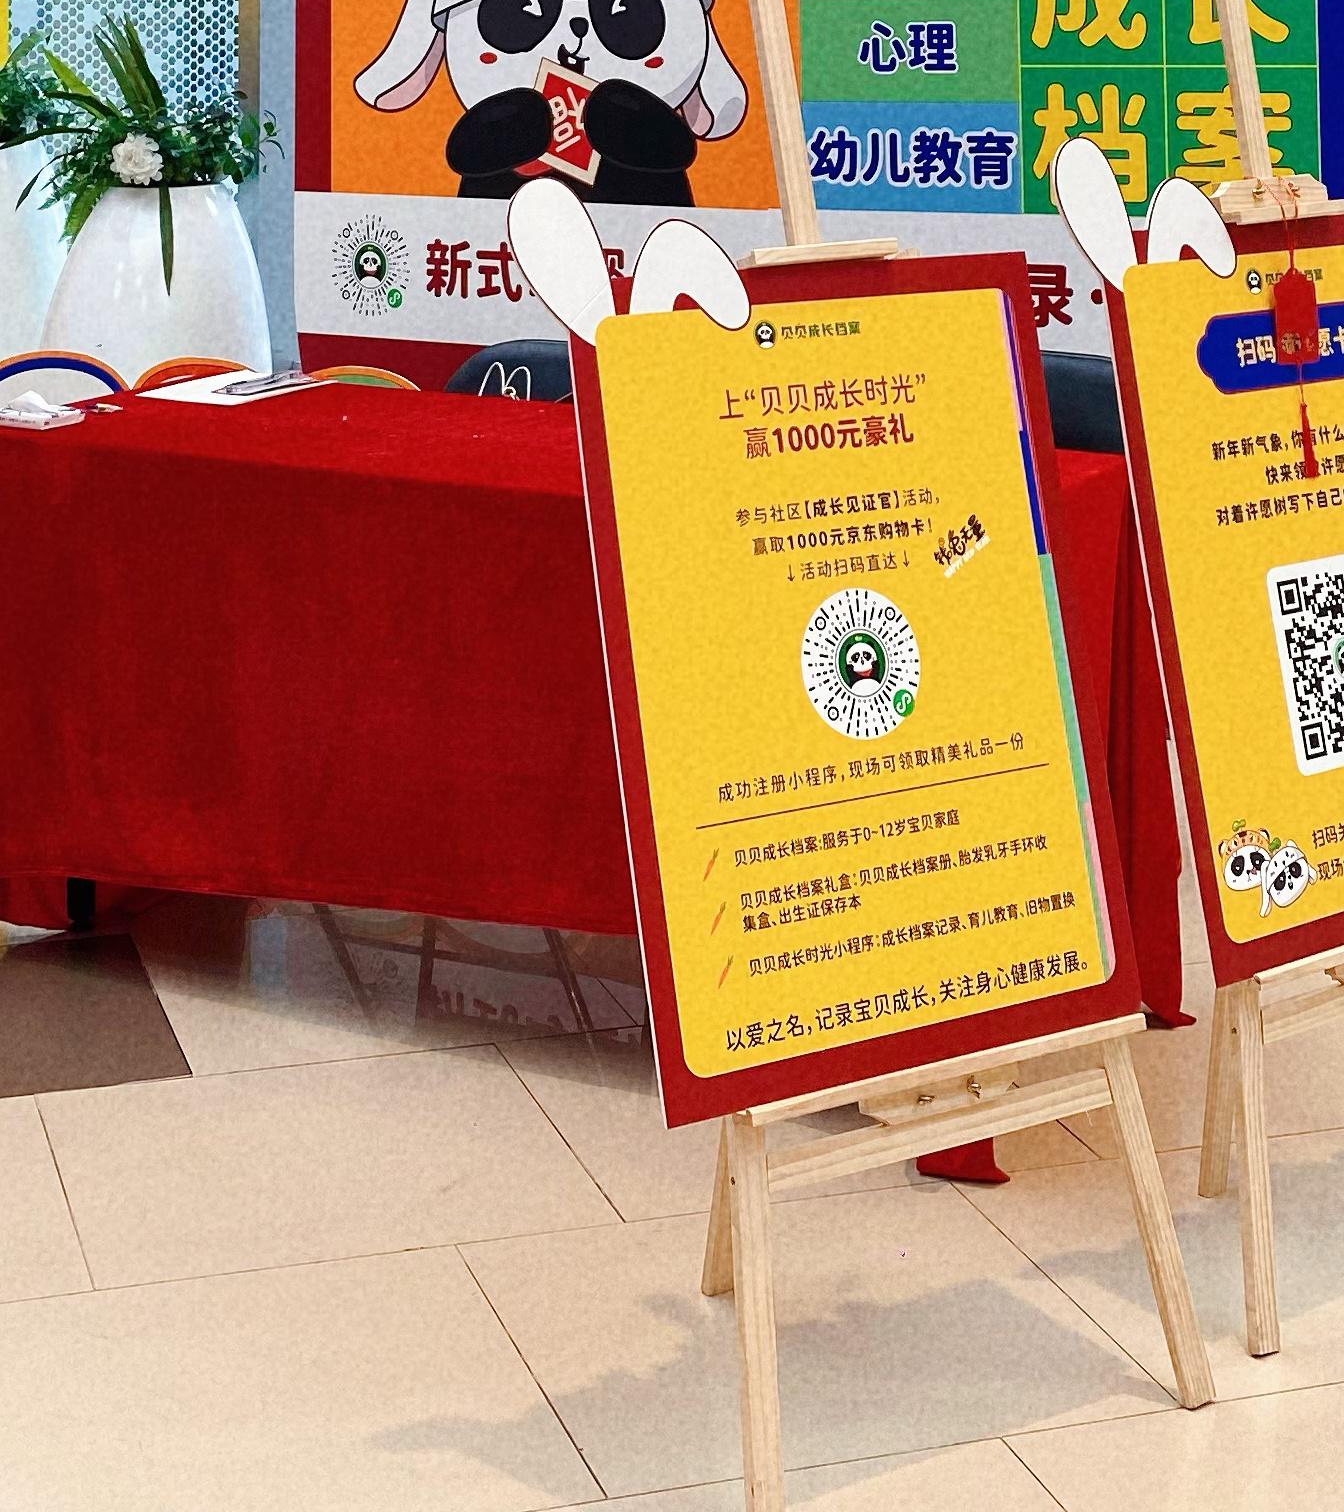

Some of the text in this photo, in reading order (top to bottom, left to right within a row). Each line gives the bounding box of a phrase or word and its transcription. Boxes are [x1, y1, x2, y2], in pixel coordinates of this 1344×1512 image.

[858, 22, 958, 78] 心理
[808, 128, 1016, 190] 幼儿教育
[743, 413, 914, 459] 赢1000元豪礼
[800, 552, 897, 581] 活动扫码直达
